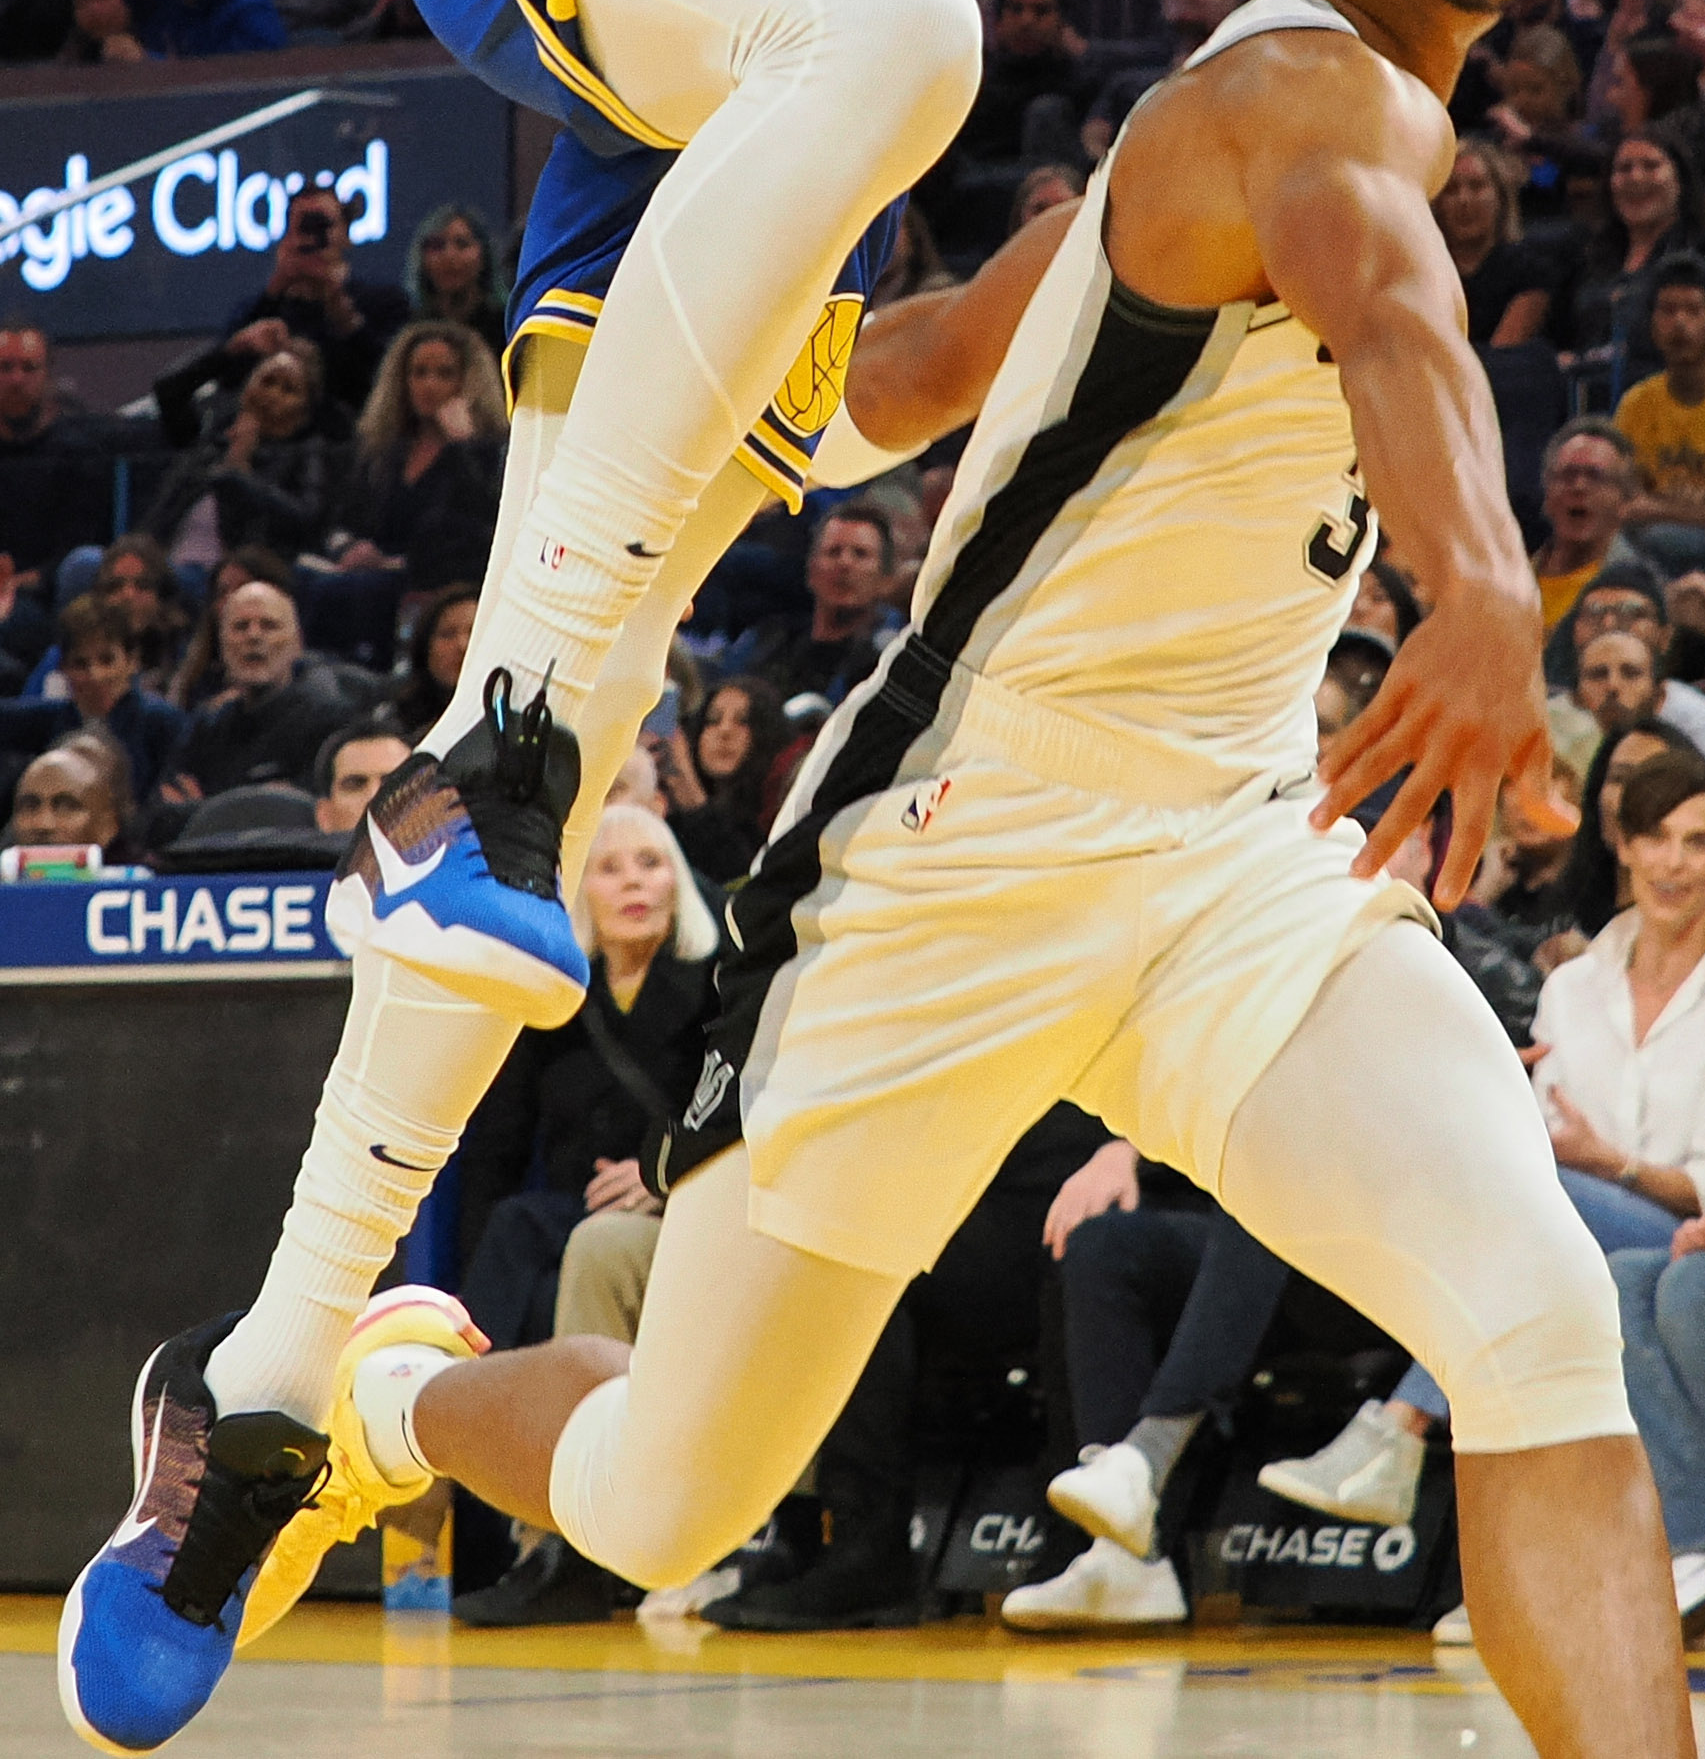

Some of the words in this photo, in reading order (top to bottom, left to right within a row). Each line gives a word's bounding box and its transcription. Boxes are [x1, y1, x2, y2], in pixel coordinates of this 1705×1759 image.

[152, 137, 390, 256] Clod
[85, 886, 317, 954] CHASE
[1220, 1523, 1373, 1567] CHASE
